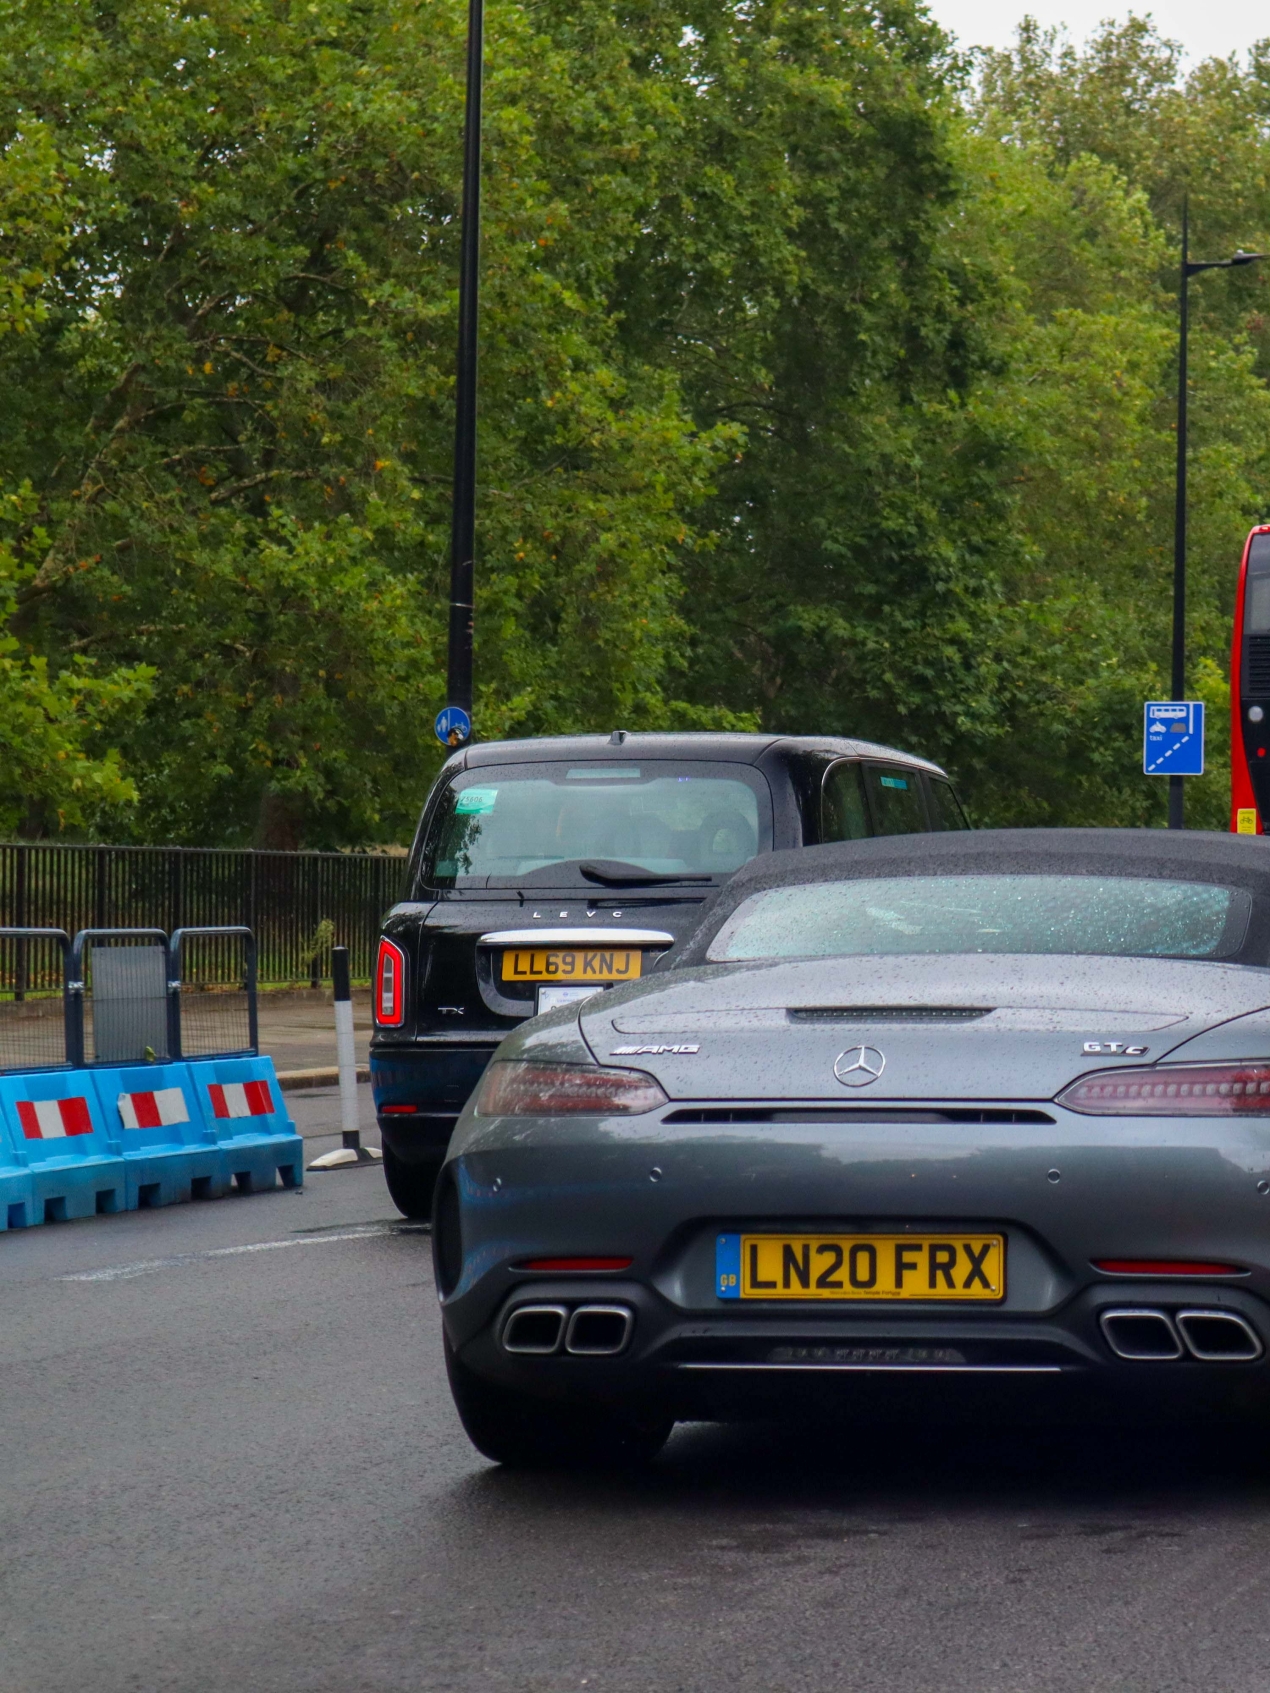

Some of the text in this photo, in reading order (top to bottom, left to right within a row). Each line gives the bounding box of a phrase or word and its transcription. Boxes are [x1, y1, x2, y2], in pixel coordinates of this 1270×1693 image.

[1149, 734, 1163, 742] taxi
[532, 911, 623, 919] LEVC
[513, 952, 631, 976] LL69 KNJ
[437, 1007, 464, 1015] TX
[636, 1044, 700, 1054] AMG
[749, 1243, 993, 1290] LN20 FRX
[720, 1273, 737, 1287] GB
